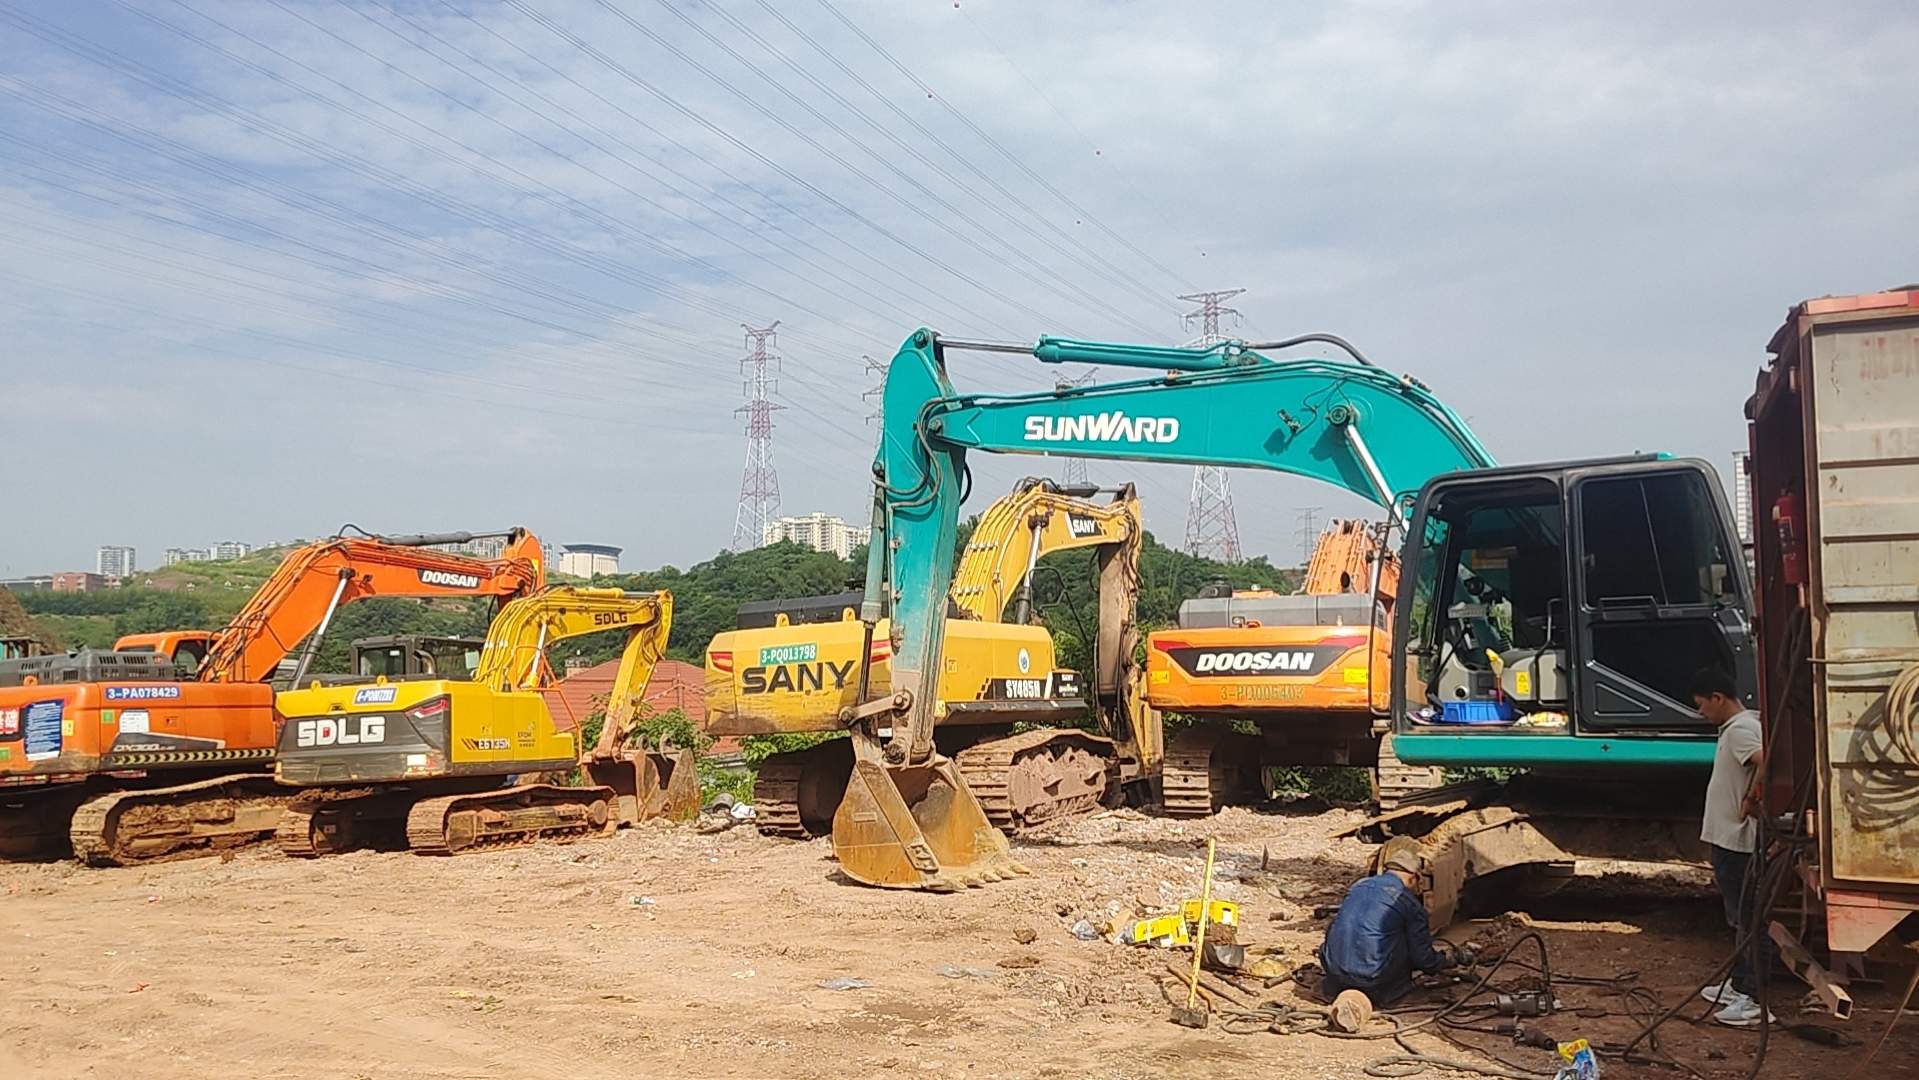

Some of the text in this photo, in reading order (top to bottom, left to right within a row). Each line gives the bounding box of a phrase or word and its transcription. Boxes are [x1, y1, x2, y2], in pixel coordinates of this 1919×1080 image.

[1024, 411, 1179, 443] SUNWARD
[1073, 519, 1095, 534] SANY
[421, 570, 478, 587] DOOSAN
[594, 612, 628, 625] SDLG
[761, 645, 816, 665] 3-PQ013798
[1196, 652, 1315, 672] DOOSAN
[742, 660, 856, 695] SANY
[108, 687, 178, 699] 3-PA078429
[297, 717, 386, 748] SDLG
